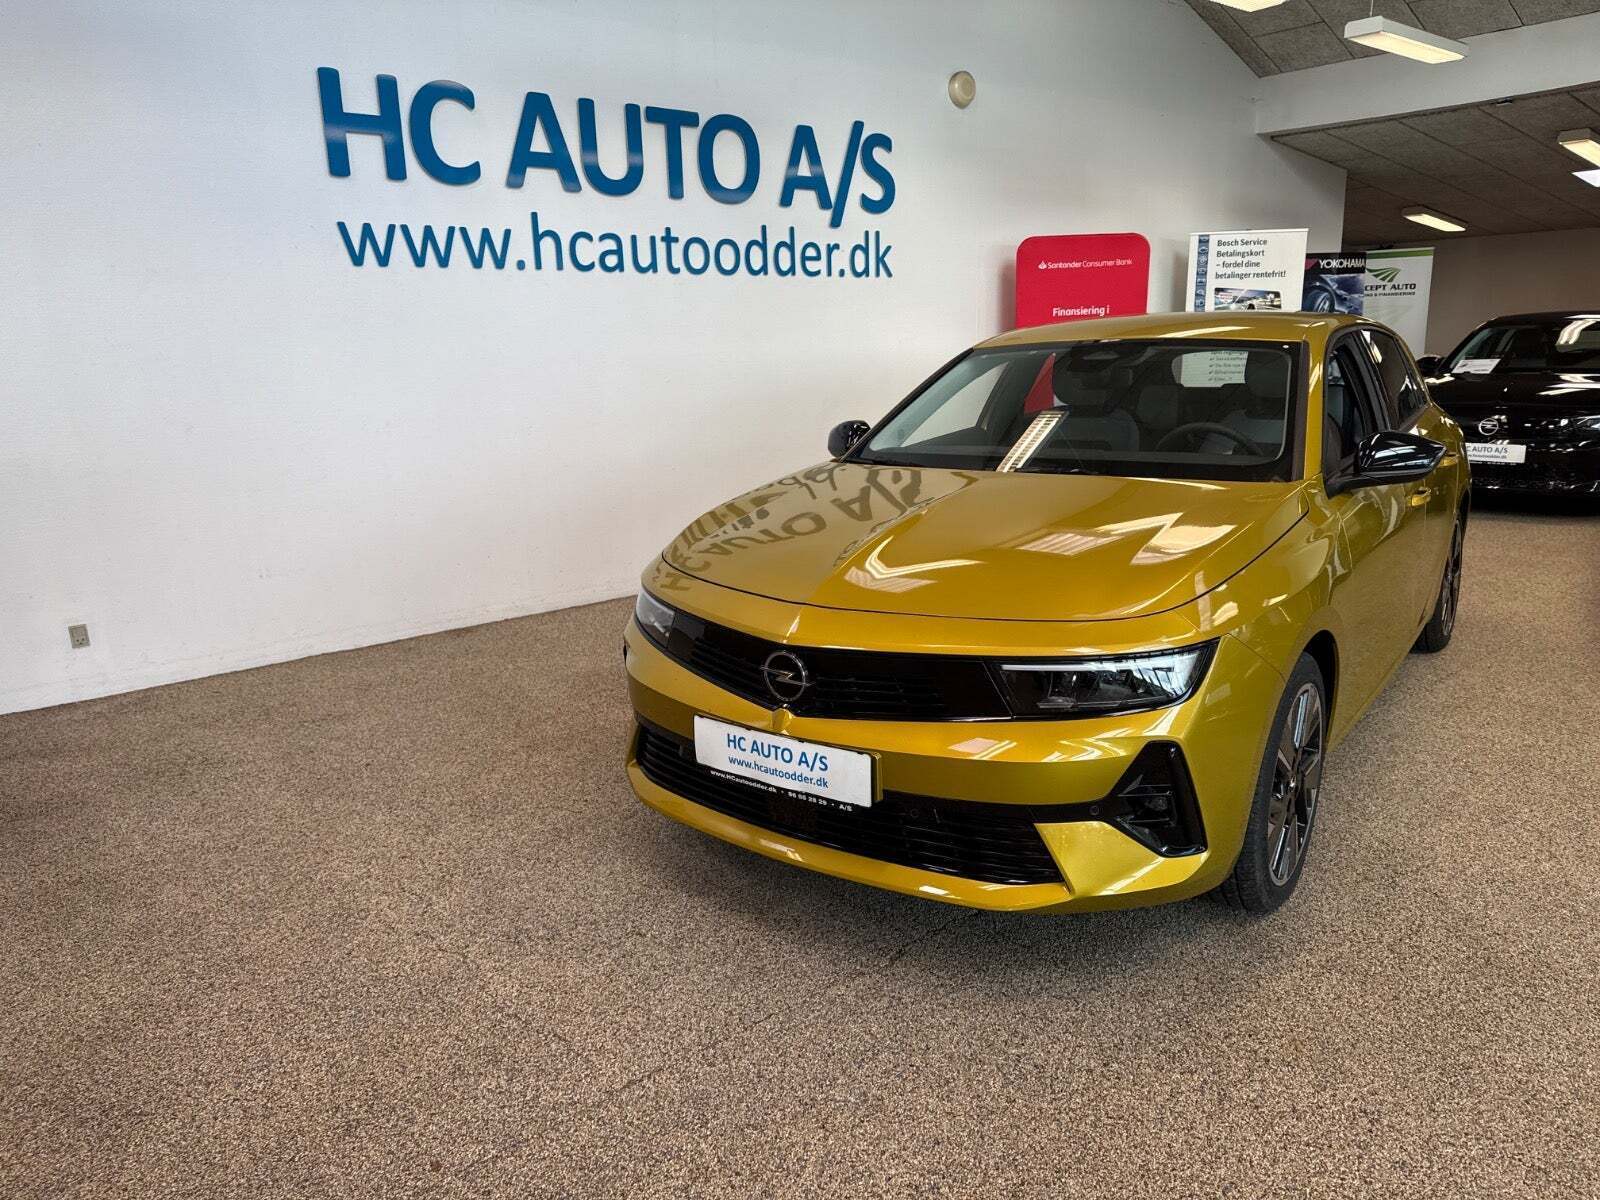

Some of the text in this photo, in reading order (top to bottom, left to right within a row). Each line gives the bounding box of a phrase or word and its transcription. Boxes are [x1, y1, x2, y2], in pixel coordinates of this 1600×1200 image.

[317, 66, 896, 229] HC AUTO A/S
[337, 211, 893, 278] www.hcautoodder.dk
[1217, 238, 1268, 247] Bosch Service
[1216, 249, 1265, 259] Betalingskort
[1047, 258, 1133, 270] Santander Consumer Bank
[1222, 260, 1244, 268] fordel
[1245, 259, 1261, 267] dine
[1319, 257, 1366, 269] YOKOHAMA
[1215, 269, 1287, 280] betalinger rentefrit!
[1364, 282, 1417, 292] CEPT AUTO
[1052, 304, 1110, 317] Finansiering i
[1494, 446, 1508, 455] A/S
[727, 733, 829, 772] HC AUTO A/S
[728, 754, 829, 789] www.hcautoodder.dk
